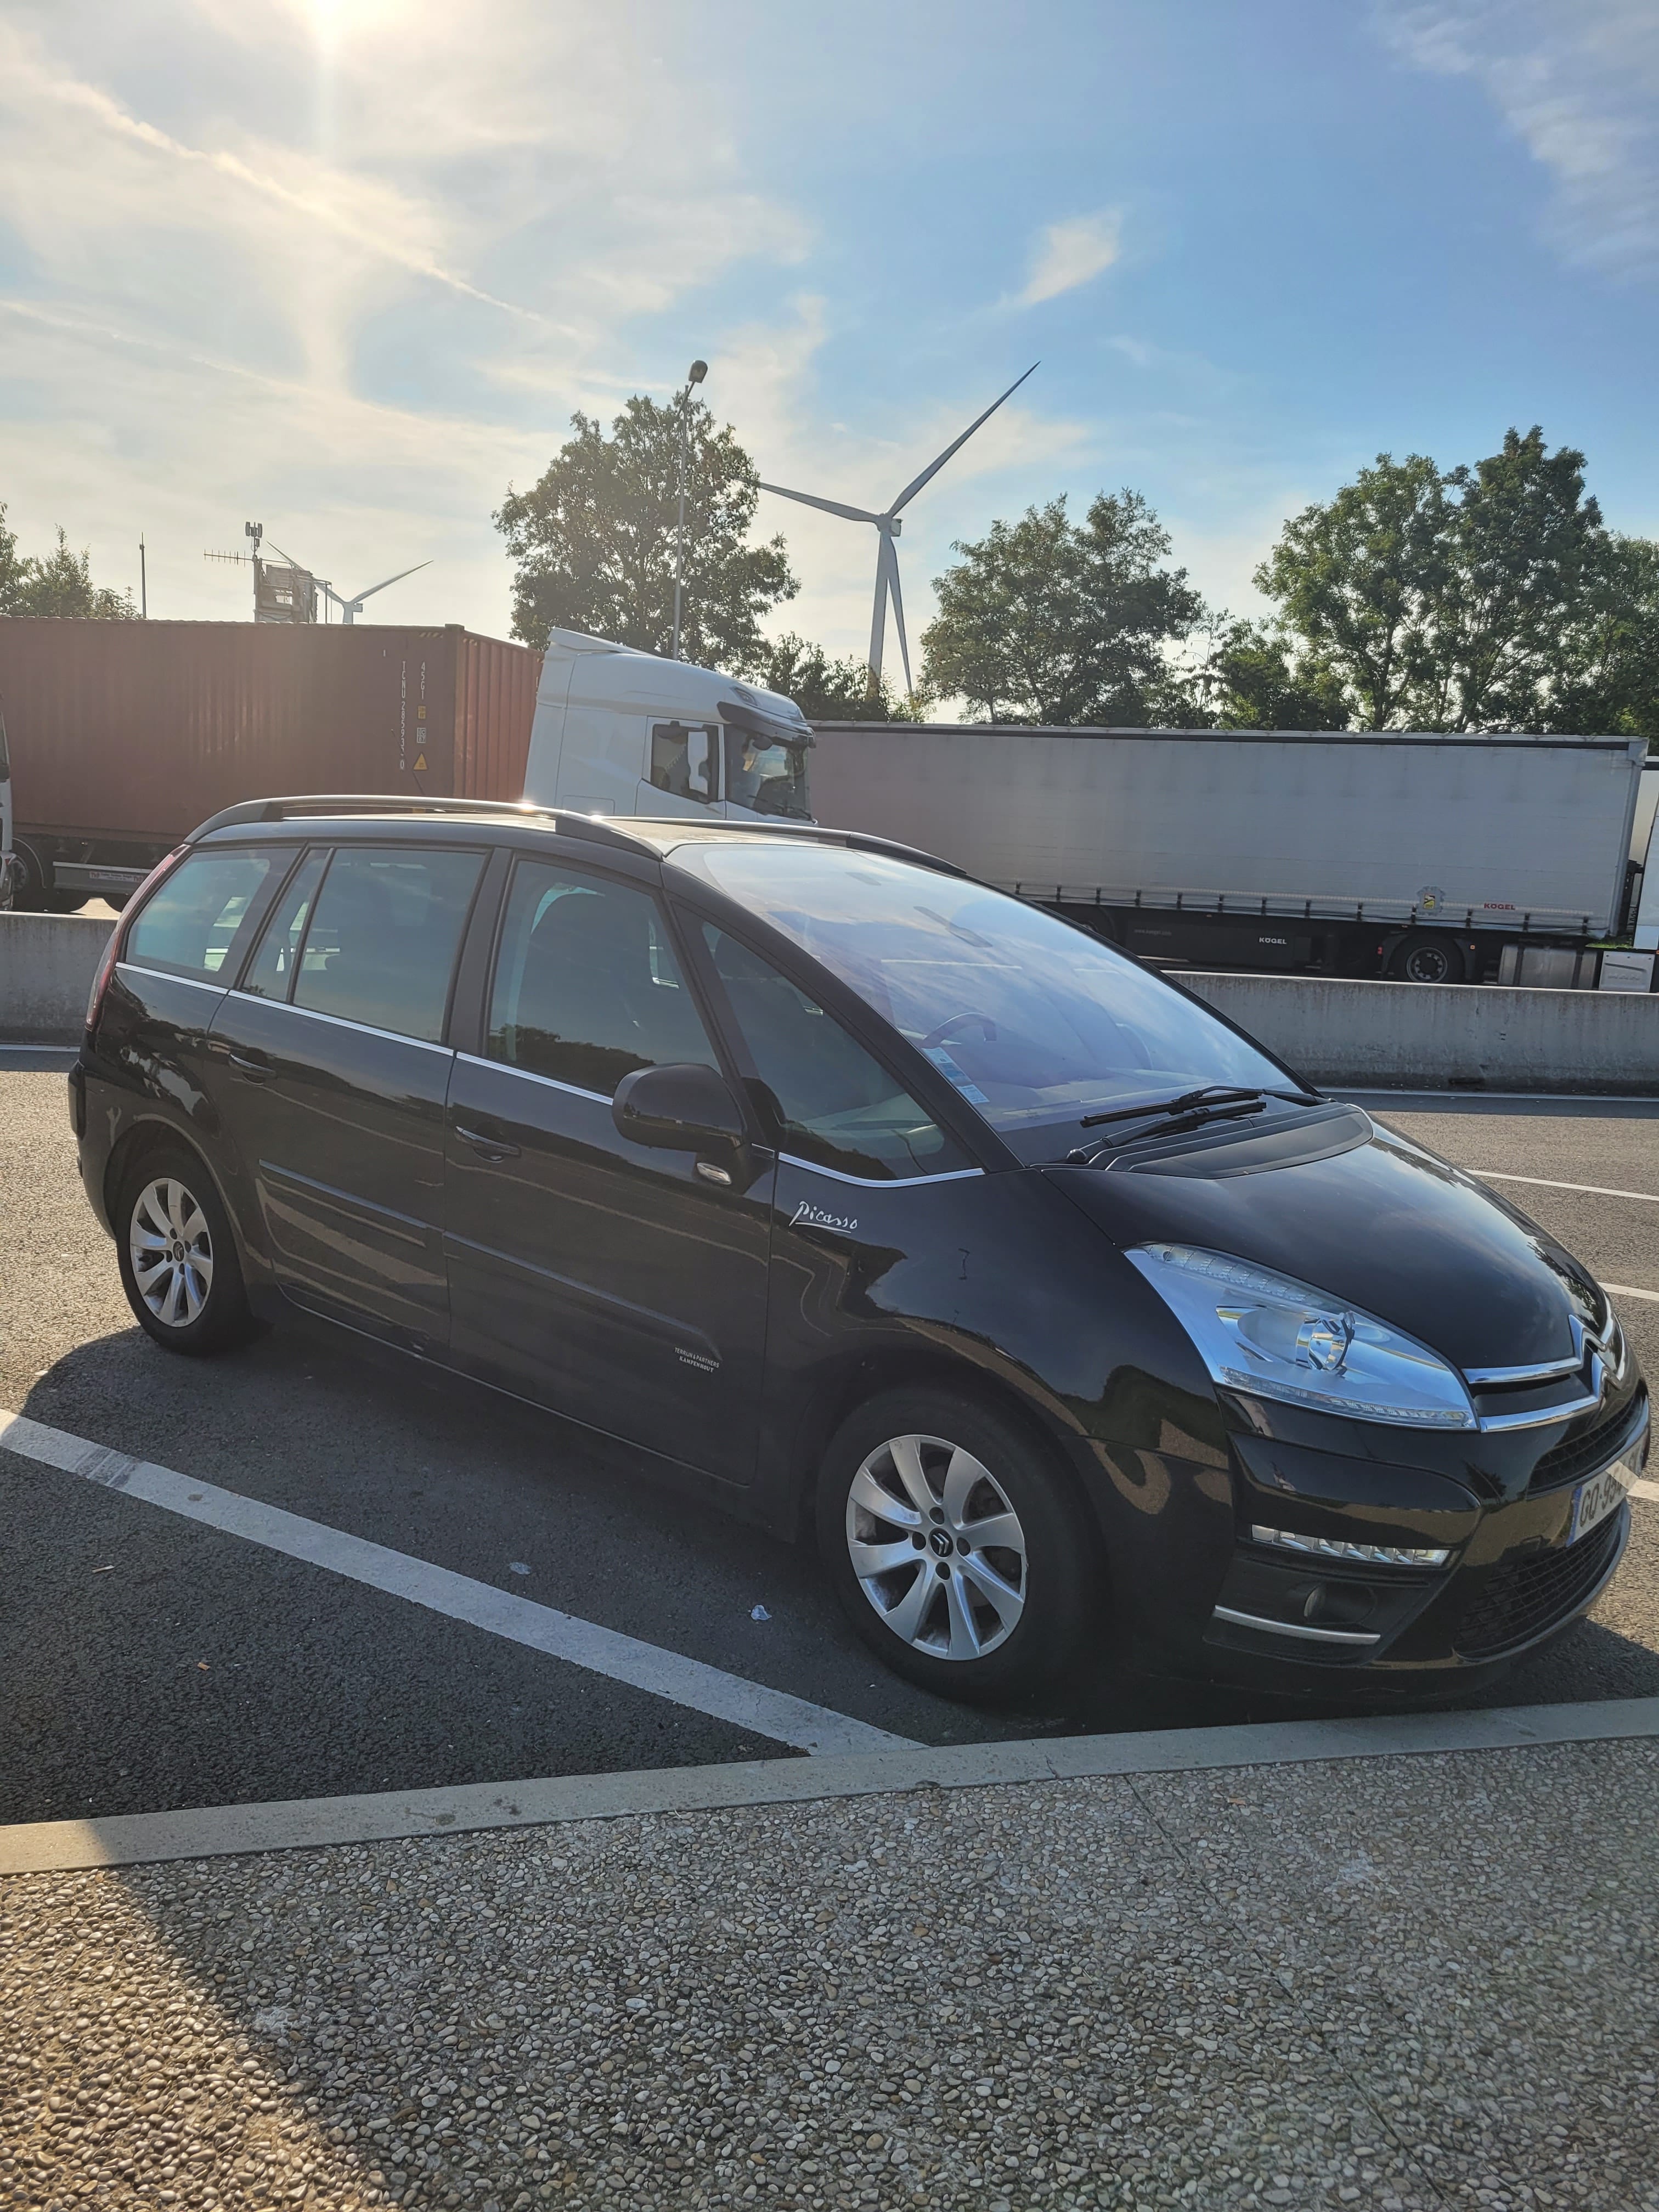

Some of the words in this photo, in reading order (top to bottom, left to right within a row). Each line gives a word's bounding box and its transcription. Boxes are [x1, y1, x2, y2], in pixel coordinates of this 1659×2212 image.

[789, 1200, 857, 1230] Picasso
[679, 1356, 714, 1373] KAMPENHOUT
[696, 1355, 720, 1368] PARTNERS
